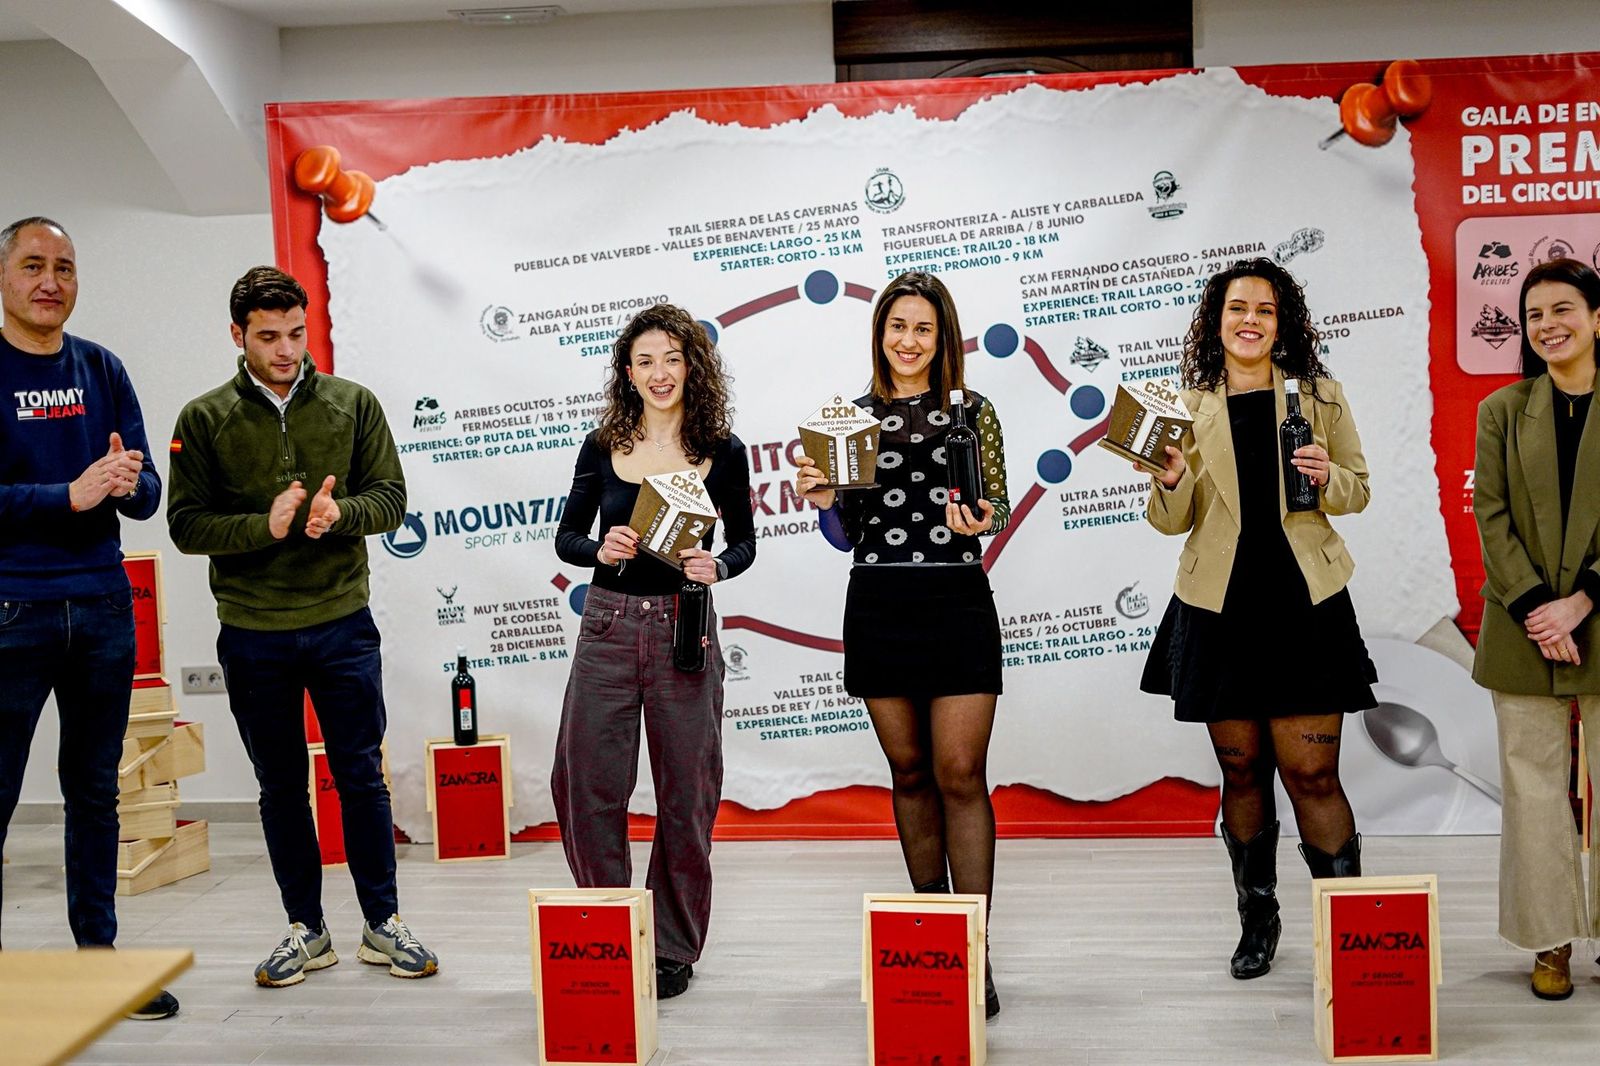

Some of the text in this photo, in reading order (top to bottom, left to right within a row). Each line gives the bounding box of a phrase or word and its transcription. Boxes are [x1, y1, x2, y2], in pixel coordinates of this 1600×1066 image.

[1461, 103, 1569, 127] GALA DE
[1462, 184, 1507, 204] DEL
[668, 223, 701, 236] TRAIL
[705, 217, 746, 231] SIERRA
[749, 214, 764, 224] DE
[767, 210, 789, 222] LAS
[793, 201, 857, 218] CAVERNAS
[881, 212, 998, 236] TRANSFRONTERIZA
[1010, 204, 1049, 219] ALISTE
[1053, 203, 1060, 212] Y
[1064, 192, 1143, 211] CARBALLEDA
[883, 214, 1084, 250] FIGUERUELA DE ARRIBA 8 JUNIO
[514, 215, 859, 272] PUEBLICA DE VALVERDE VALLES DE BENAVENTE 25 MAYO
[693, 229, 861, 261] EXPERIENCE: LARGO 25 KM
[885, 232, 1059, 264] EXPERIENCE: TRAIL20 18 KM
[720, 243, 862, 271] STARTER: CORTO 13 KM
[944, 249, 1043, 270] PROMO10 9 KM
[1020, 273, 1047, 284] CXM
[1051, 262, 1119, 280] FERNANDO
[1122, 252, 1189, 270] CASQUERO
[1201, 241, 1265, 259] SANABRIA
[1022, 286, 1047, 299] SAN
[1051, 279, 1099, 295] MARTÍN
[1102, 277, 1117, 288] DE
[1121, 265, 1194, 285] CASTAÑEDA
[1023, 282, 1182, 312] EXPERIENCE: TRAIL LARGO
[518, 305, 588, 323] ZANGARÚN
[591, 303, 605, 313] DE
[609, 294, 669, 310] RICOBAYO
[1025, 296, 1184, 326] STARTER: TRAIL CORTO 10
[1323, 306, 1404, 325] CARBALLEDA
[529, 323, 560, 335] ALBA
[563, 321, 570, 330] Y
[575, 316, 612, 329] ALISTE
[1118, 341, 1152, 353] TRAIL
[14, 388, 84, 407] TOMMY
[1127, 385, 1187, 418] CIRCUITO PROVINCIAL
[1144, 381, 1179, 405] CXM
[454, 398, 554, 419] ARRIBES OCULTOS
[821, 406, 856, 419] CXM
[1142, 400, 1167, 414] ZAMORA
[462, 409, 577, 432] FERMOSELLE 18 Y 19
[836, 418, 872, 426] PROVINCIAL
[1123, 410, 1144, 449] STARTER
[465, 424, 570, 445] GP RUTA DEL VINO
[864, 434, 874, 451] 1
[1141, 420, 1165, 458] SENIOR
[1168, 424, 1183, 440] 3
[432, 437, 575, 462] STARTER: GP CAJA RURAL
[828, 440, 837, 483] STARTER
[848, 440, 859, 481] SENIOR
[653, 478, 711, 513] CIRCUITO PROVINCIAL
[670, 474, 705, 499] CXM
[1060, 489, 1098, 502] ULTRA
[667, 493, 691, 509] ZAMORA
[1062, 499, 1125, 516] SANABRIA
[642, 505, 667, 544] STARTER
[688, 520, 704, 537] 2
[1064, 512, 1138, 529] EXPERIENCE:
[464, 533, 508, 550] SPORT
[512, 531, 522, 544] &
[660, 515, 687, 554] SENIOR
[473, 597, 558, 614] MUY SILVESTRE
[1001, 605, 1102, 626] LA RAYA ALISTE
[493, 611, 561, 625] DE CODESAL
[1044, 617, 1116, 634] 26 OCTUBRE
[491, 623, 562, 639] CARBALLEDA
[1045, 636, 1079, 647] TRAIL
[1082, 629, 1125, 643] LARGO
[1136, 626, 1151, 636] 26
[490, 636, 565, 652] 28 DICIEMBRE
[1027, 640, 1150, 663] TRAIL CORTO 14 KM
[443, 649, 568, 672] STRTER: TRAIL 8 KM
[799, 672, 832, 683] TRAIL
[773, 687, 815, 699] VALLES
[818, 685, 832, 694] DE
[771, 703, 785, 713] DE
[789, 701, 810, 711] REY
[822, 698, 833, 707] 16
[736, 708, 862, 729] EXPERIENCE: MEDIA20
[760, 720, 869, 740] STARTER: PROMO10
[439, 772, 498, 787] ZAMORA
[548, 941, 630, 960] ZAMORA
[1339, 931, 1425, 951] ZAMORA
[879, 949, 964, 970] ZAMORA
